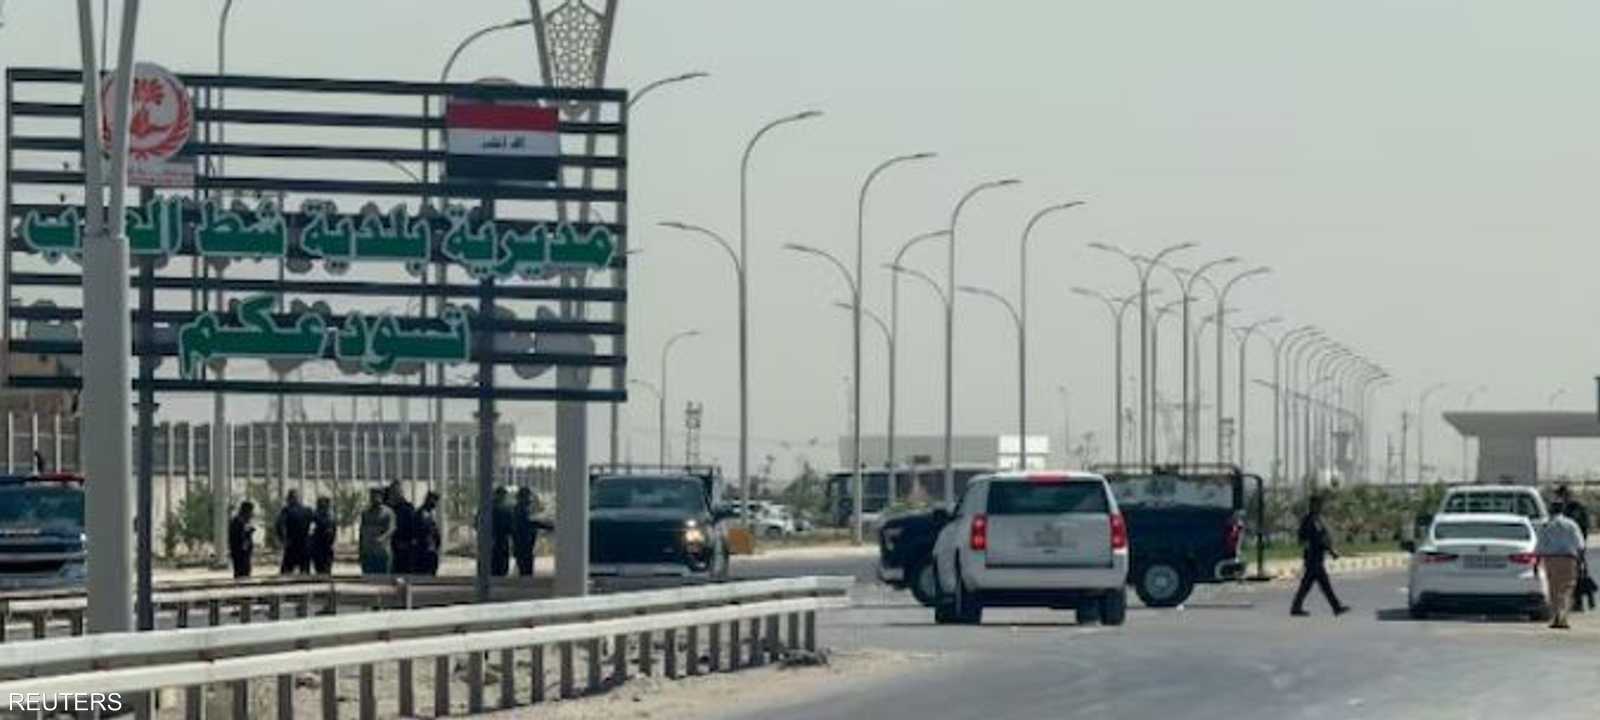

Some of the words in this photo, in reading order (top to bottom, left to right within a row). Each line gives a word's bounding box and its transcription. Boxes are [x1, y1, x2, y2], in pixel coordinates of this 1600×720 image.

[23, 196, 183, 263] الب
[196, 198, 288, 257] شط
[302, 199, 431, 275] بلدية
[441, 202, 616, 279] مديرية
